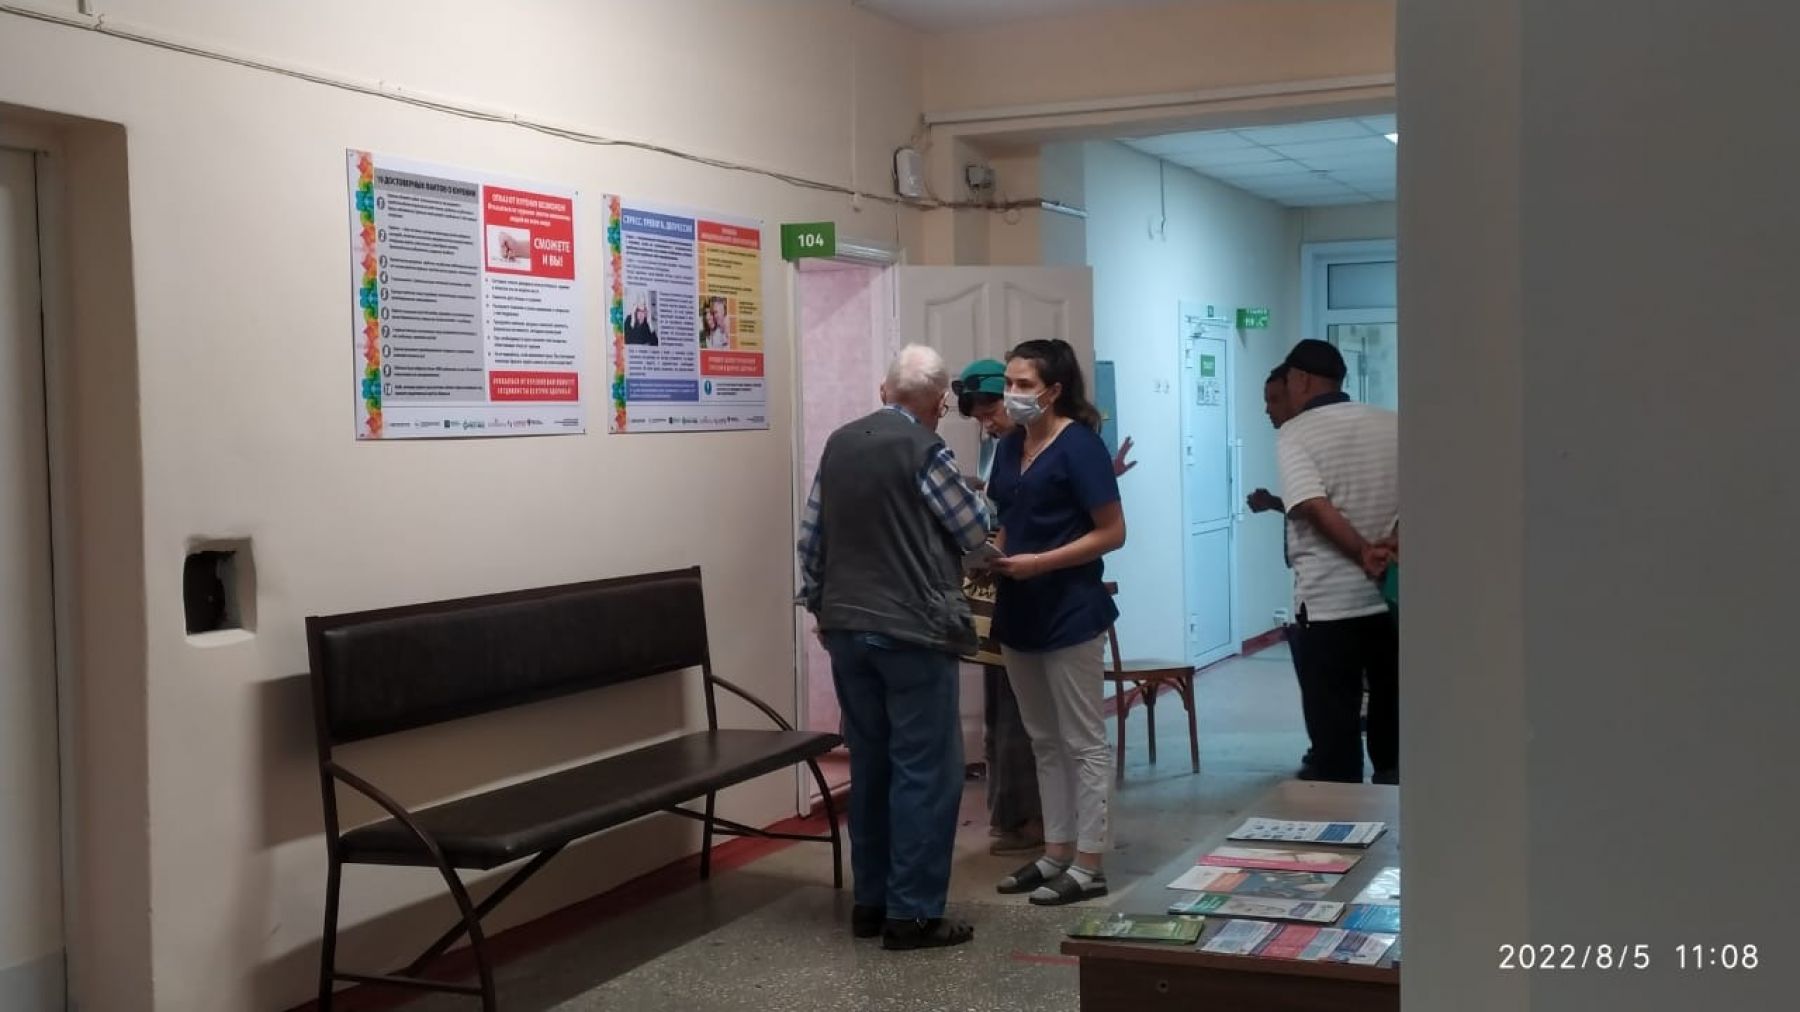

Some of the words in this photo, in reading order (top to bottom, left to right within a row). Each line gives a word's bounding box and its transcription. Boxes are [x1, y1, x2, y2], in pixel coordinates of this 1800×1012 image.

[533, 237, 571, 253] СМОЖЕТЕ
[798, 232, 824, 247] 104
[542, 253, 548, 266] И
[549, 254, 563, 267] ВЫ!
